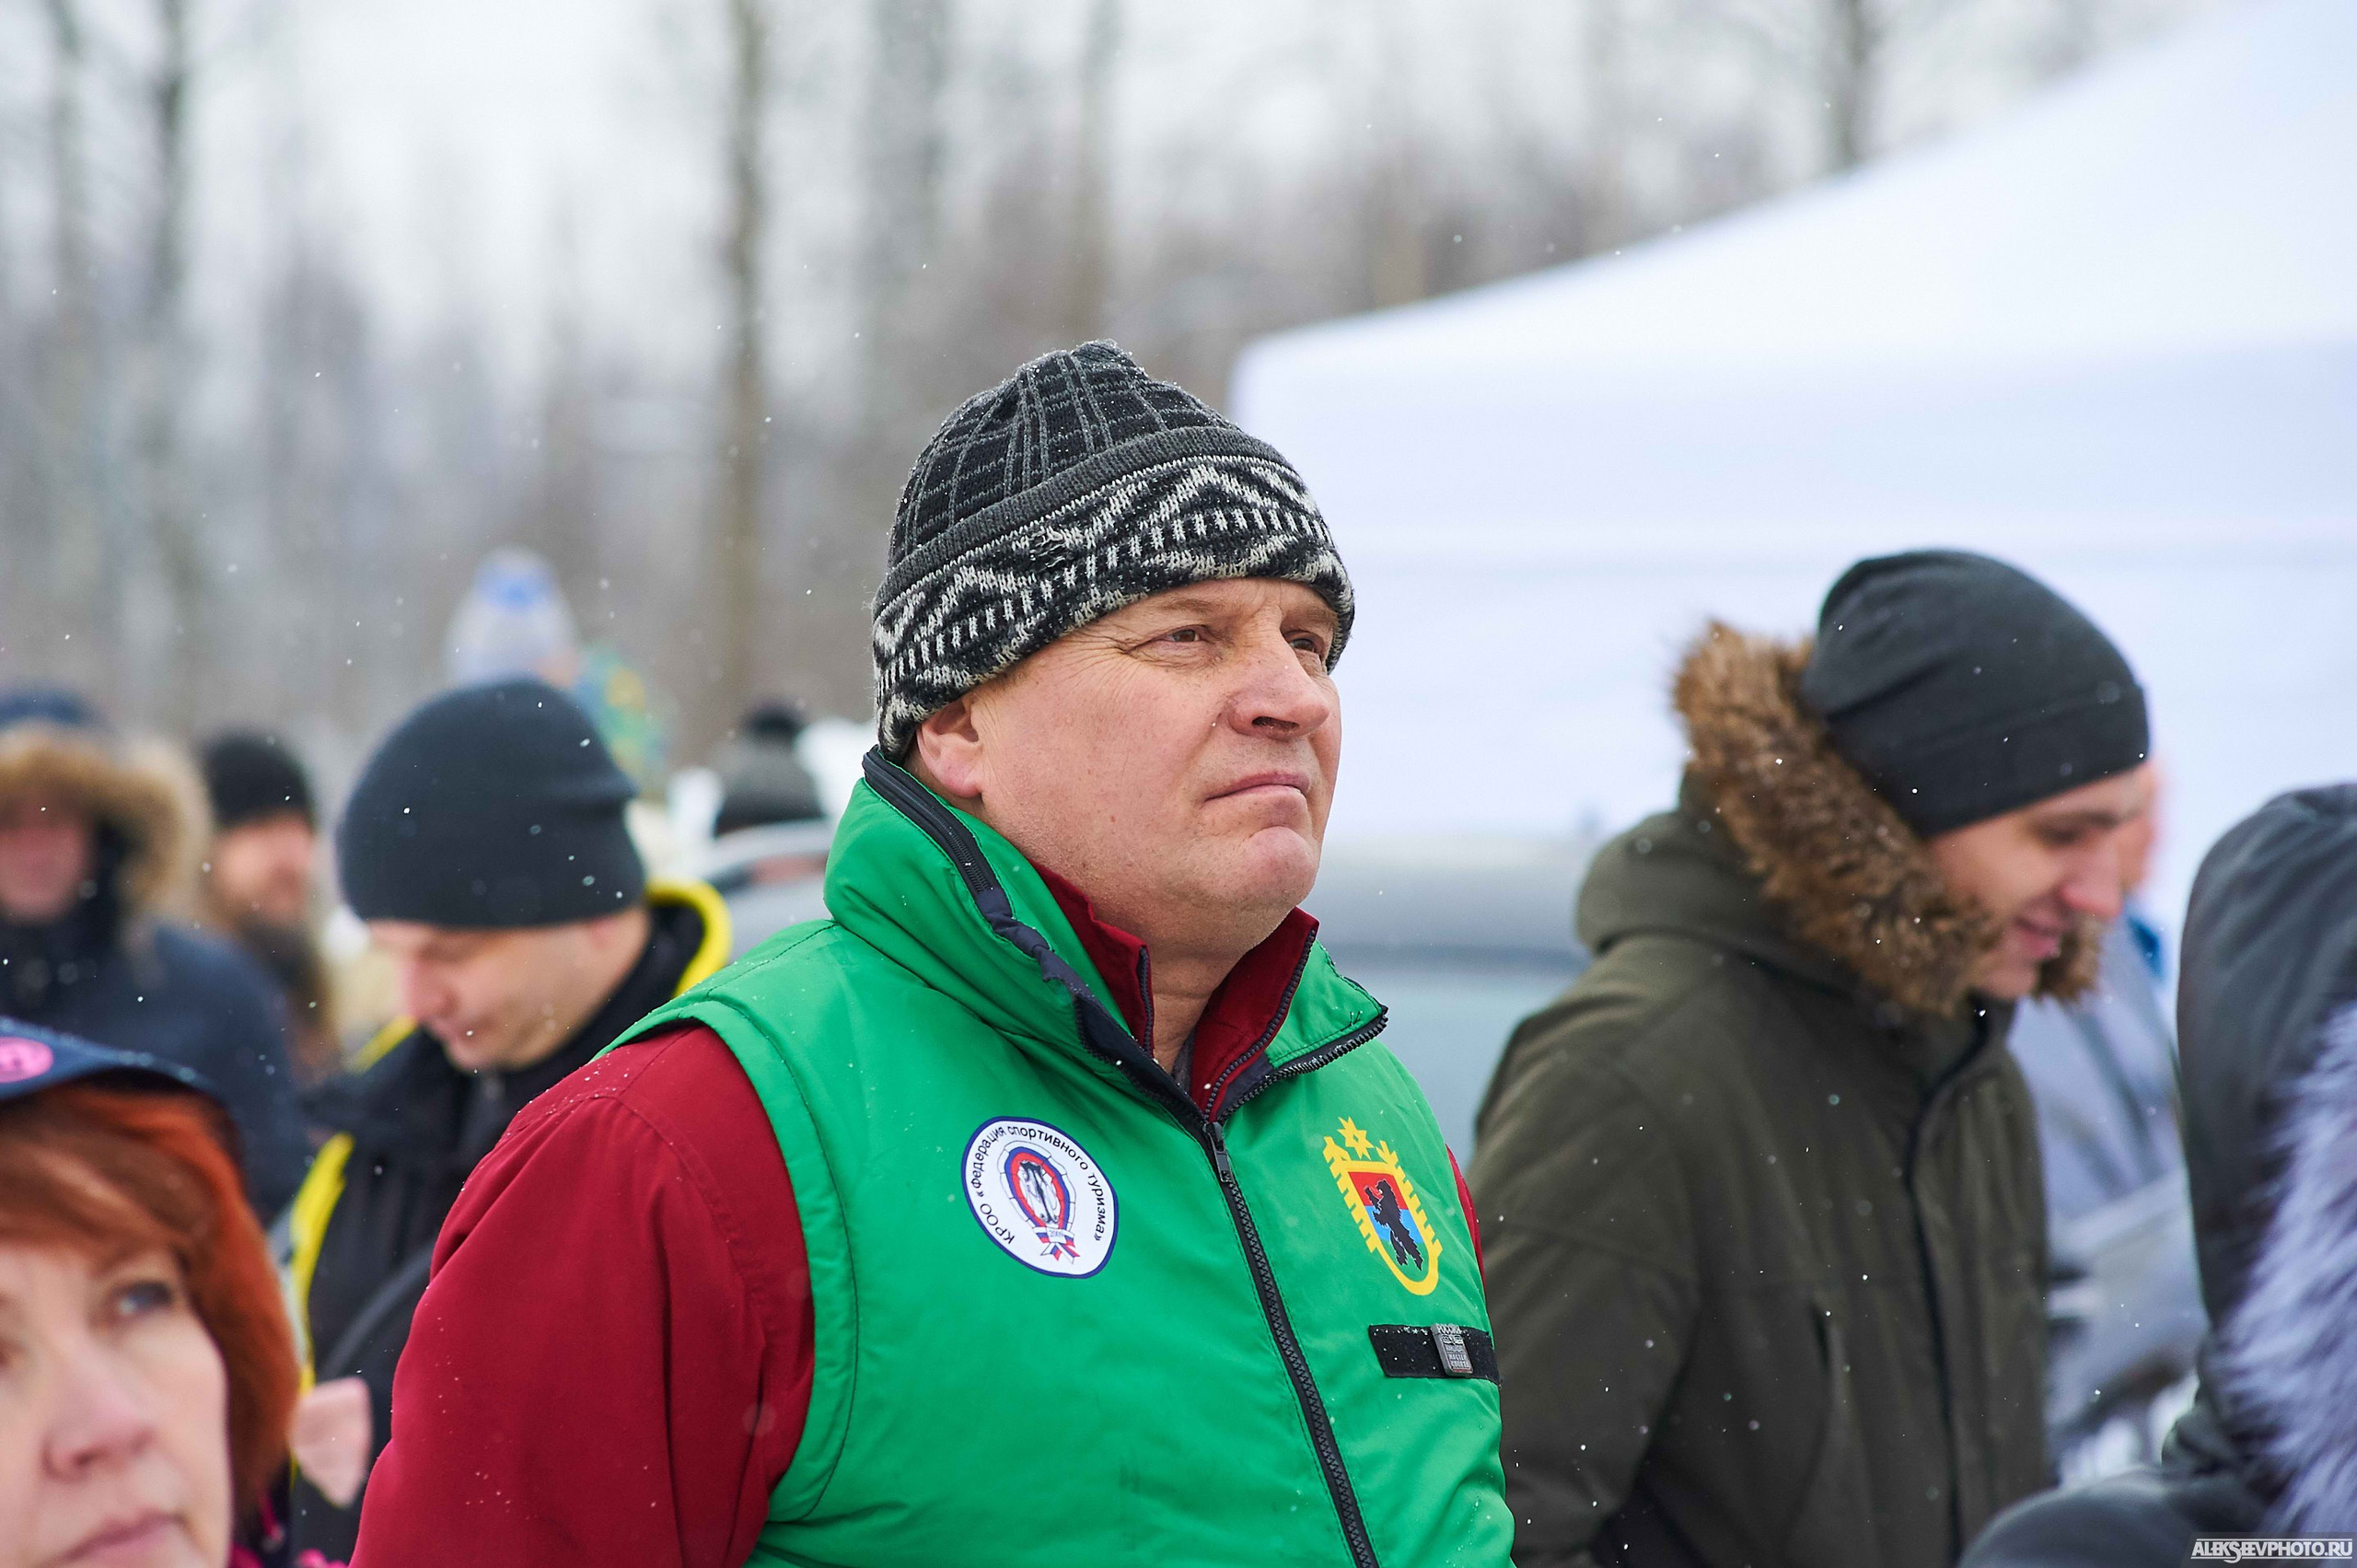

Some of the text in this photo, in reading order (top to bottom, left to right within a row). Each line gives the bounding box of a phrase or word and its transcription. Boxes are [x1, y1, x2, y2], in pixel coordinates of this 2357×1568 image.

[970, 1125, 1107, 1245] КРОО «Федерация спортивного туризма»
